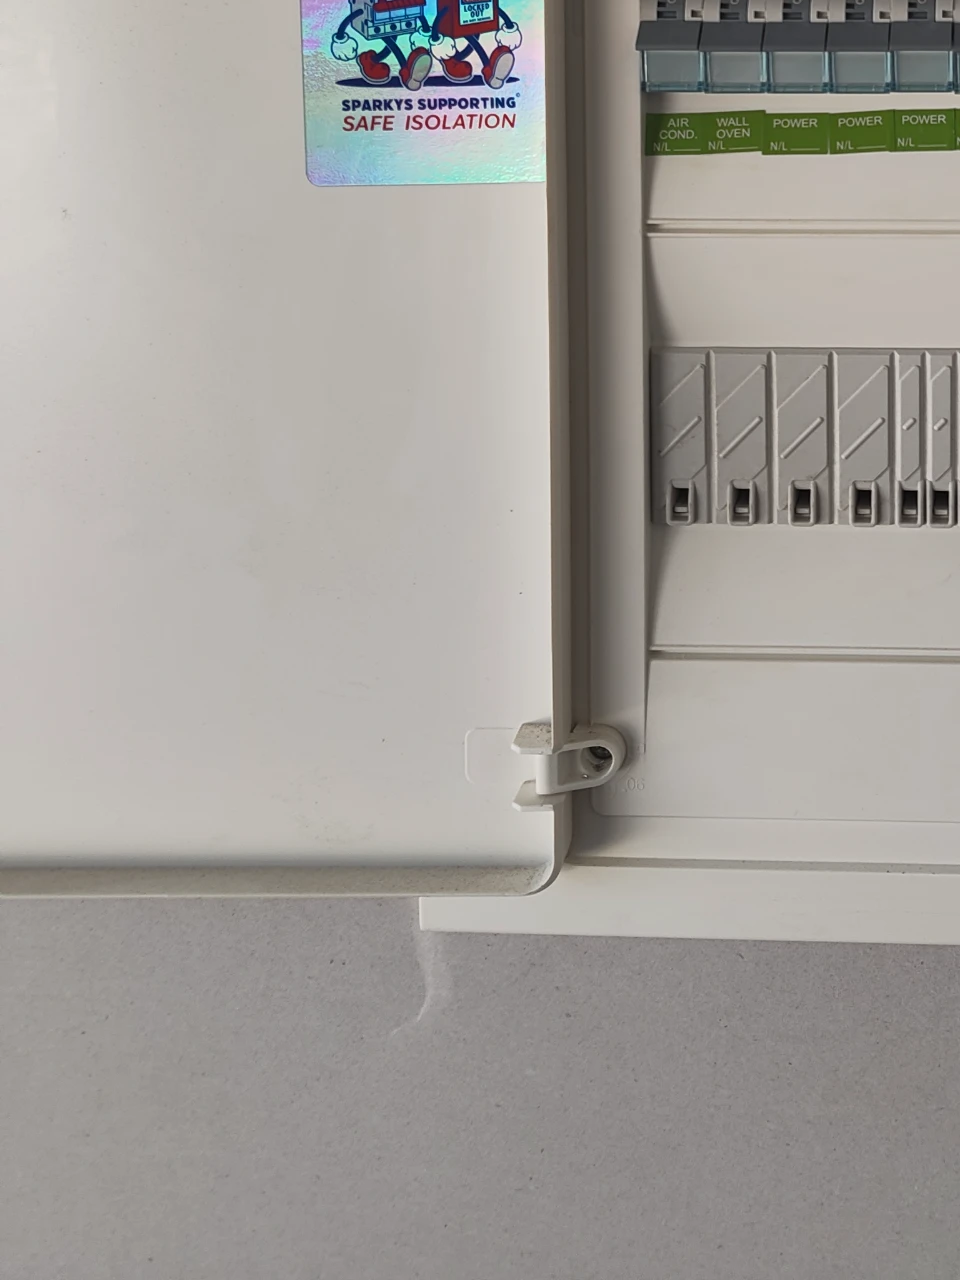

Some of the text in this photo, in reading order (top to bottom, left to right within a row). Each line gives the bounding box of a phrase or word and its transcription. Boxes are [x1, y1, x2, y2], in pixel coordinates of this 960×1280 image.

[463, 3, 490, 13] LOCKED
[470, 10, 484, 18] OUT
[342, 98, 414, 112] SPARKYS
[342, 113, 517, 132] SAFE ISOLATION
[667, 118, 690, 128] AIR
[716, 117, 749, 128] WALL
[773, 118, 818, 129] POWER
[838, 116, 883, 127] POWER
[902, 114, 947, 125] POWER
[659, 129, 698, 140] COND.
[716, 128, 751, 140] OVEN
